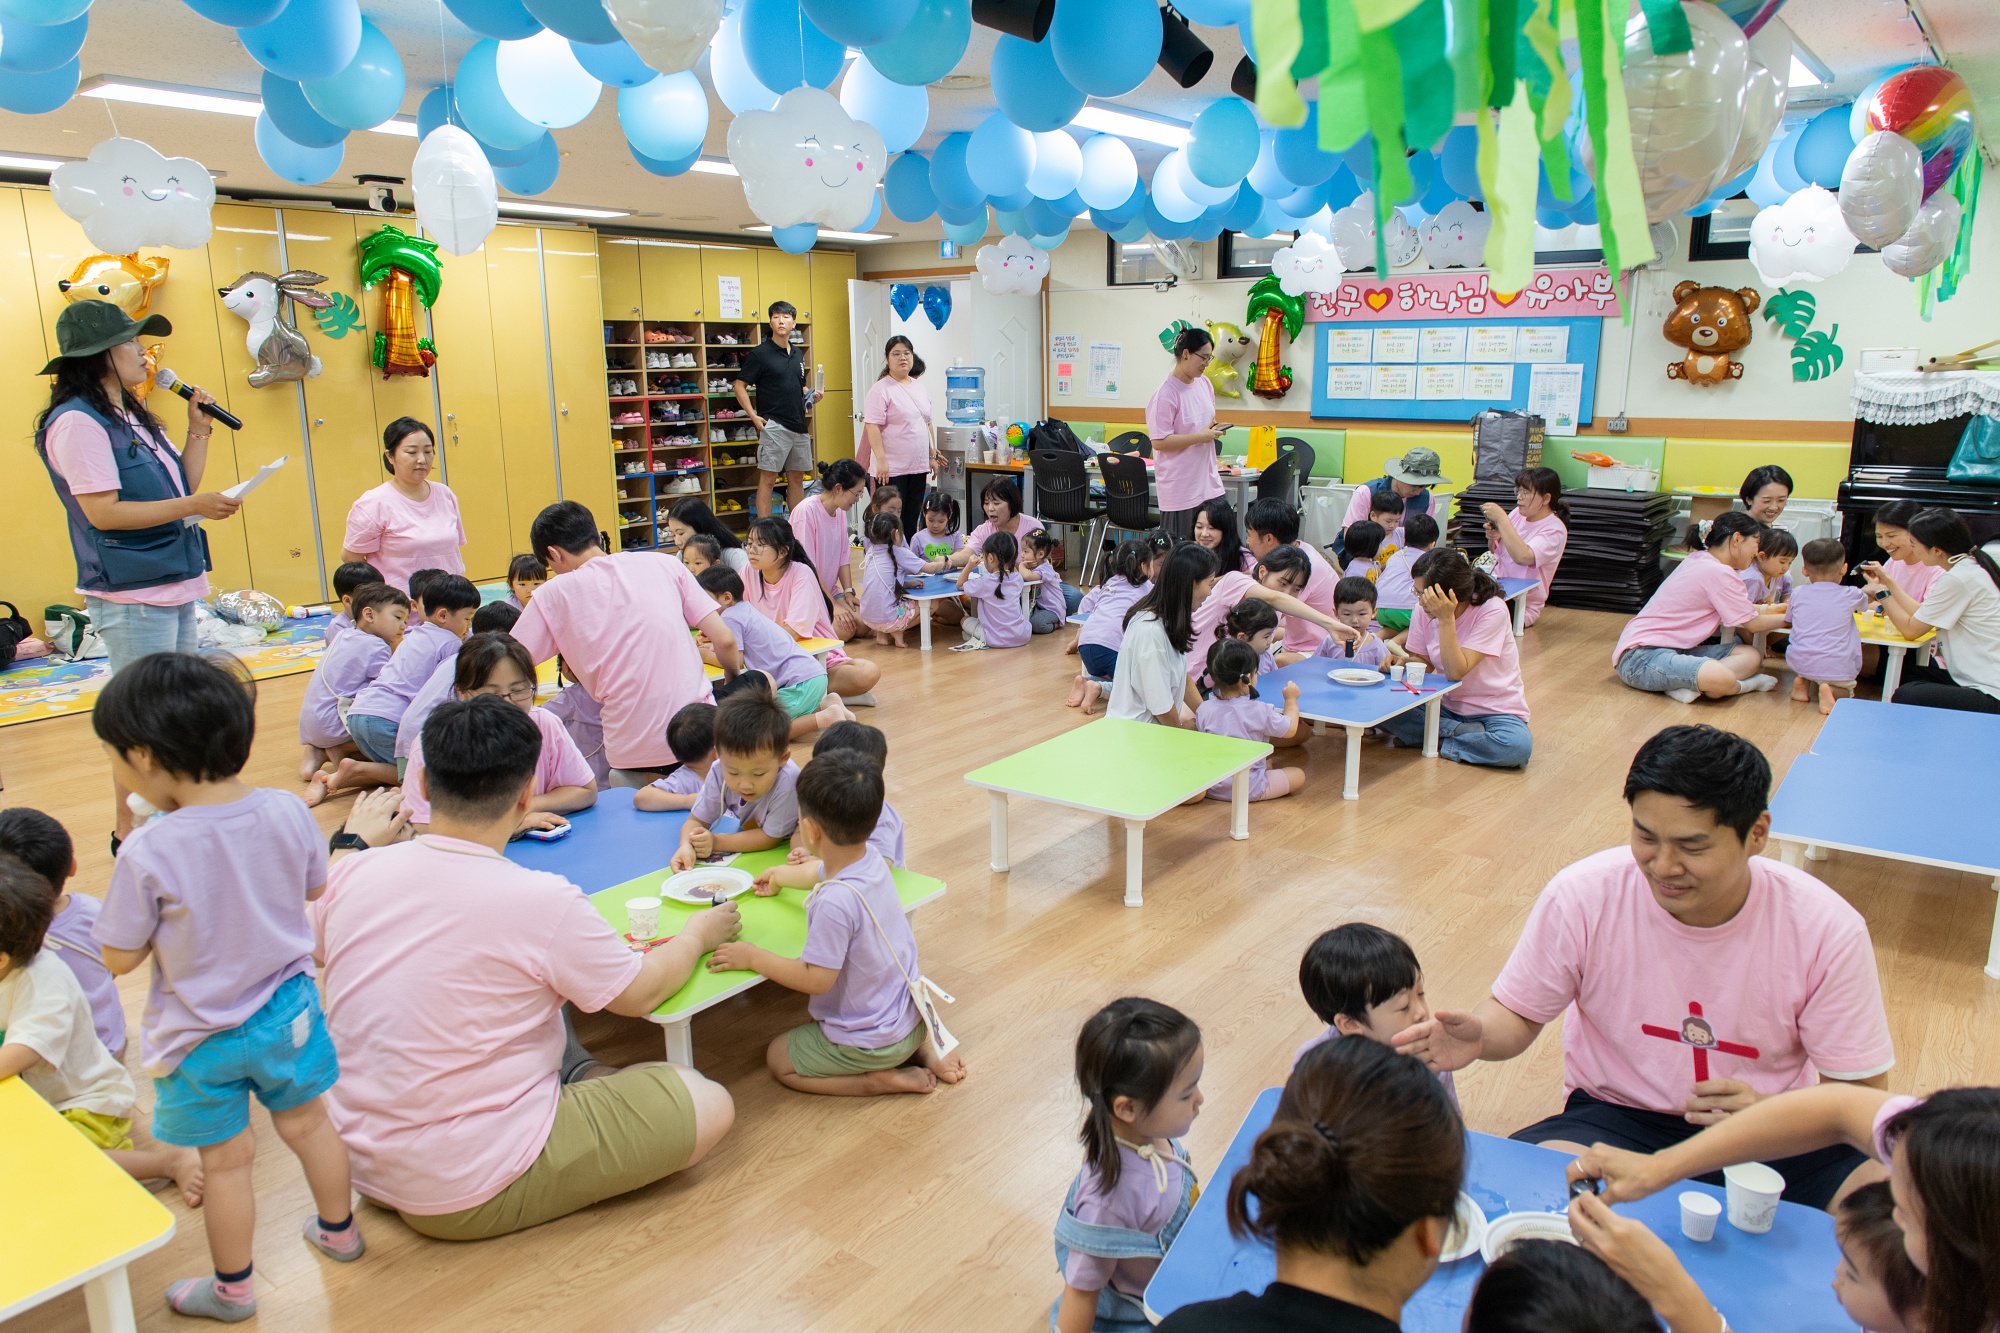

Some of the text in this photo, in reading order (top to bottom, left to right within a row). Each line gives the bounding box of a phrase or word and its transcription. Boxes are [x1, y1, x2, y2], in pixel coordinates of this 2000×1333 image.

[1398, 275, 1489, 314] 하나님
[1525, 273, 1616, 310] 유아부
[1528, 433, 1544, 443] AND
